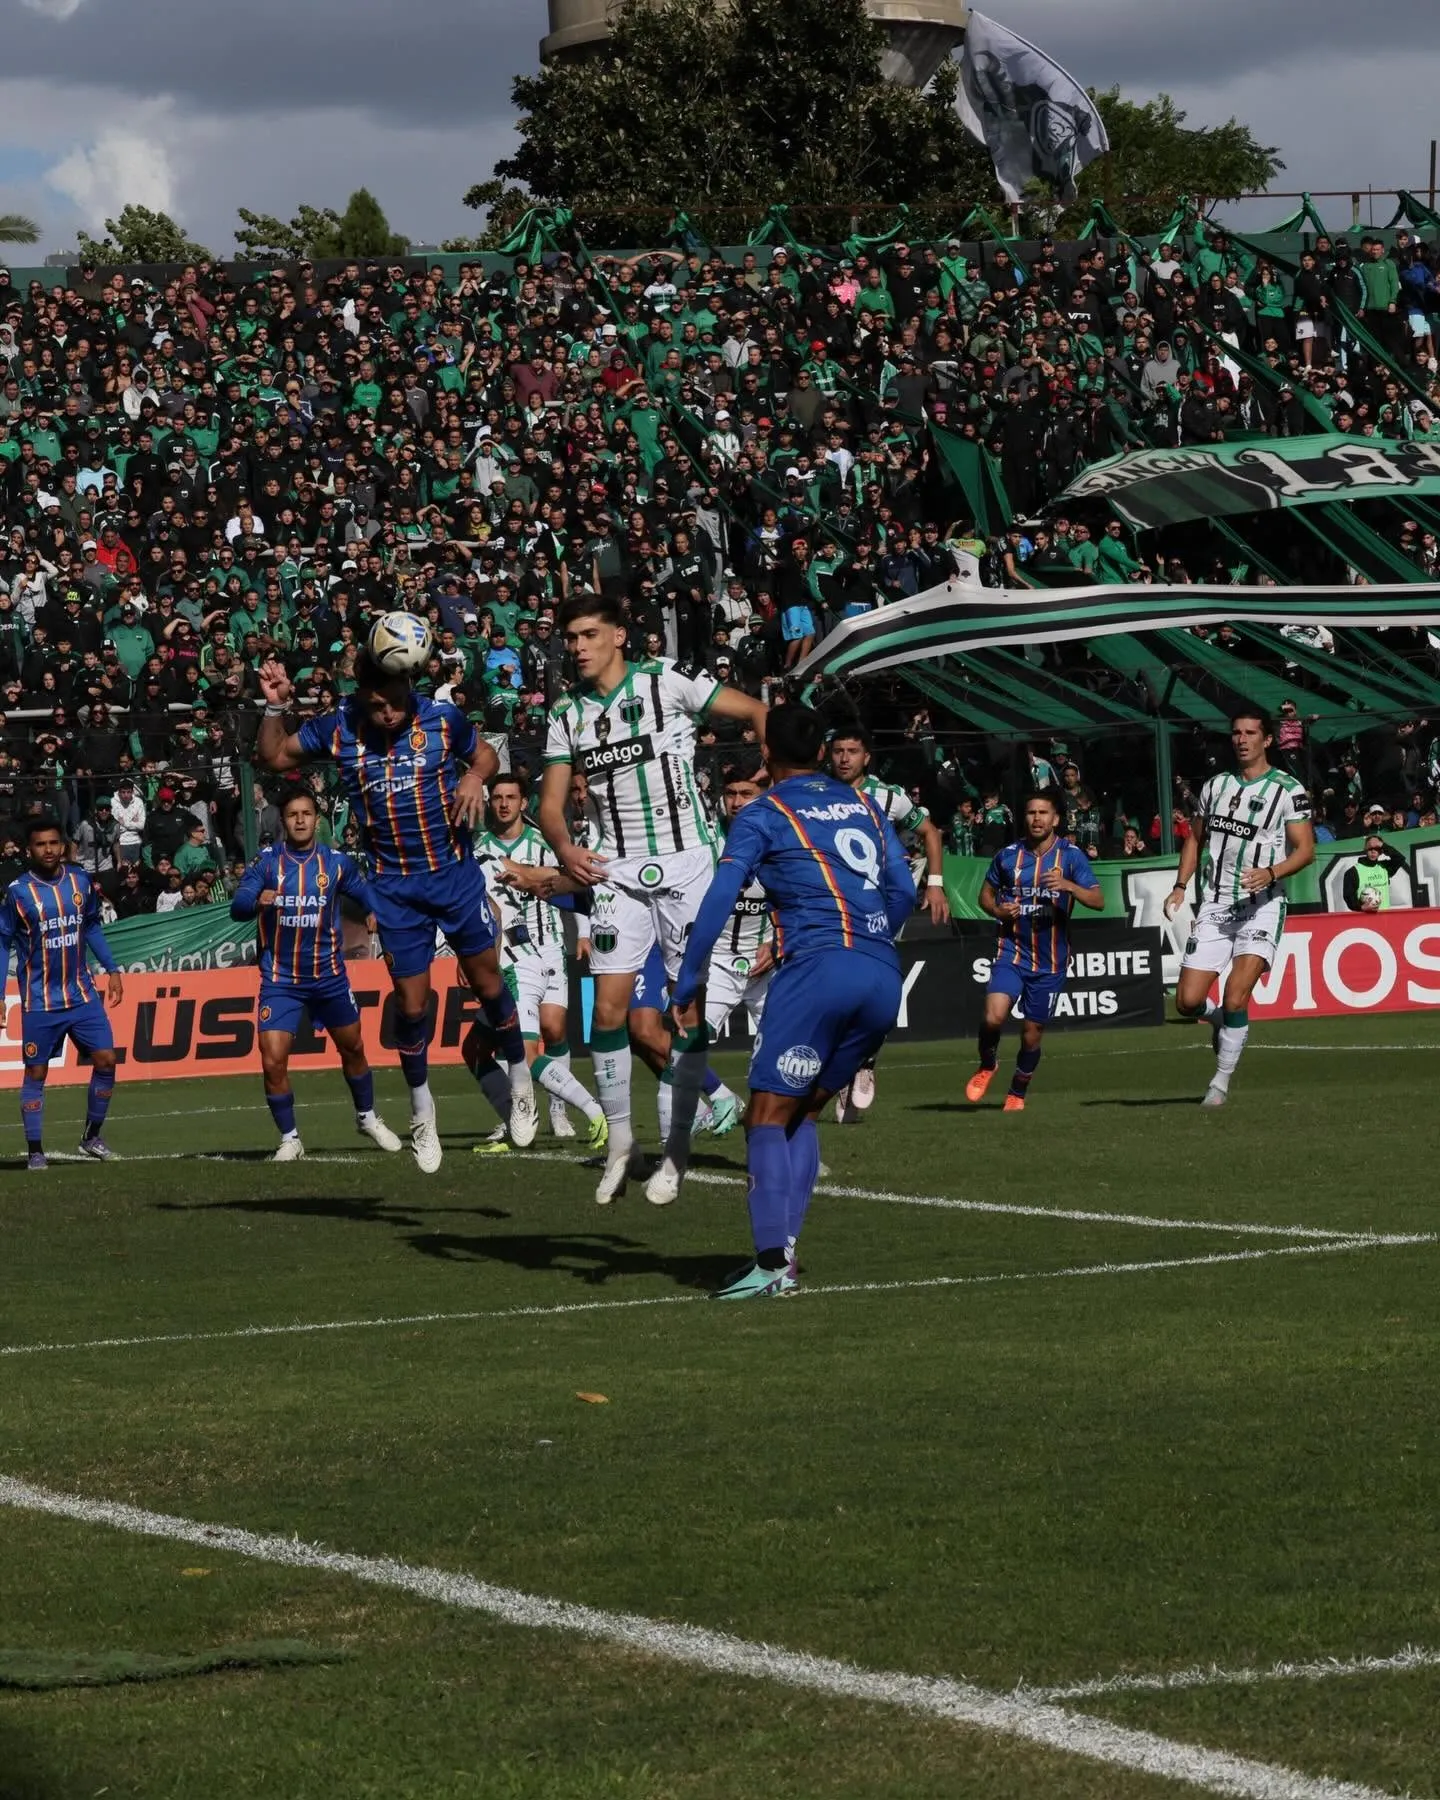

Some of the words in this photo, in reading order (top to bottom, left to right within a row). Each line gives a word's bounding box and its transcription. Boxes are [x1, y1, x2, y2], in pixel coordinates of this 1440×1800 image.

[584, 742, 643, 770] cketgo
[834, 828, 880, 890] 9
[634, 974, 647, 993] 2
